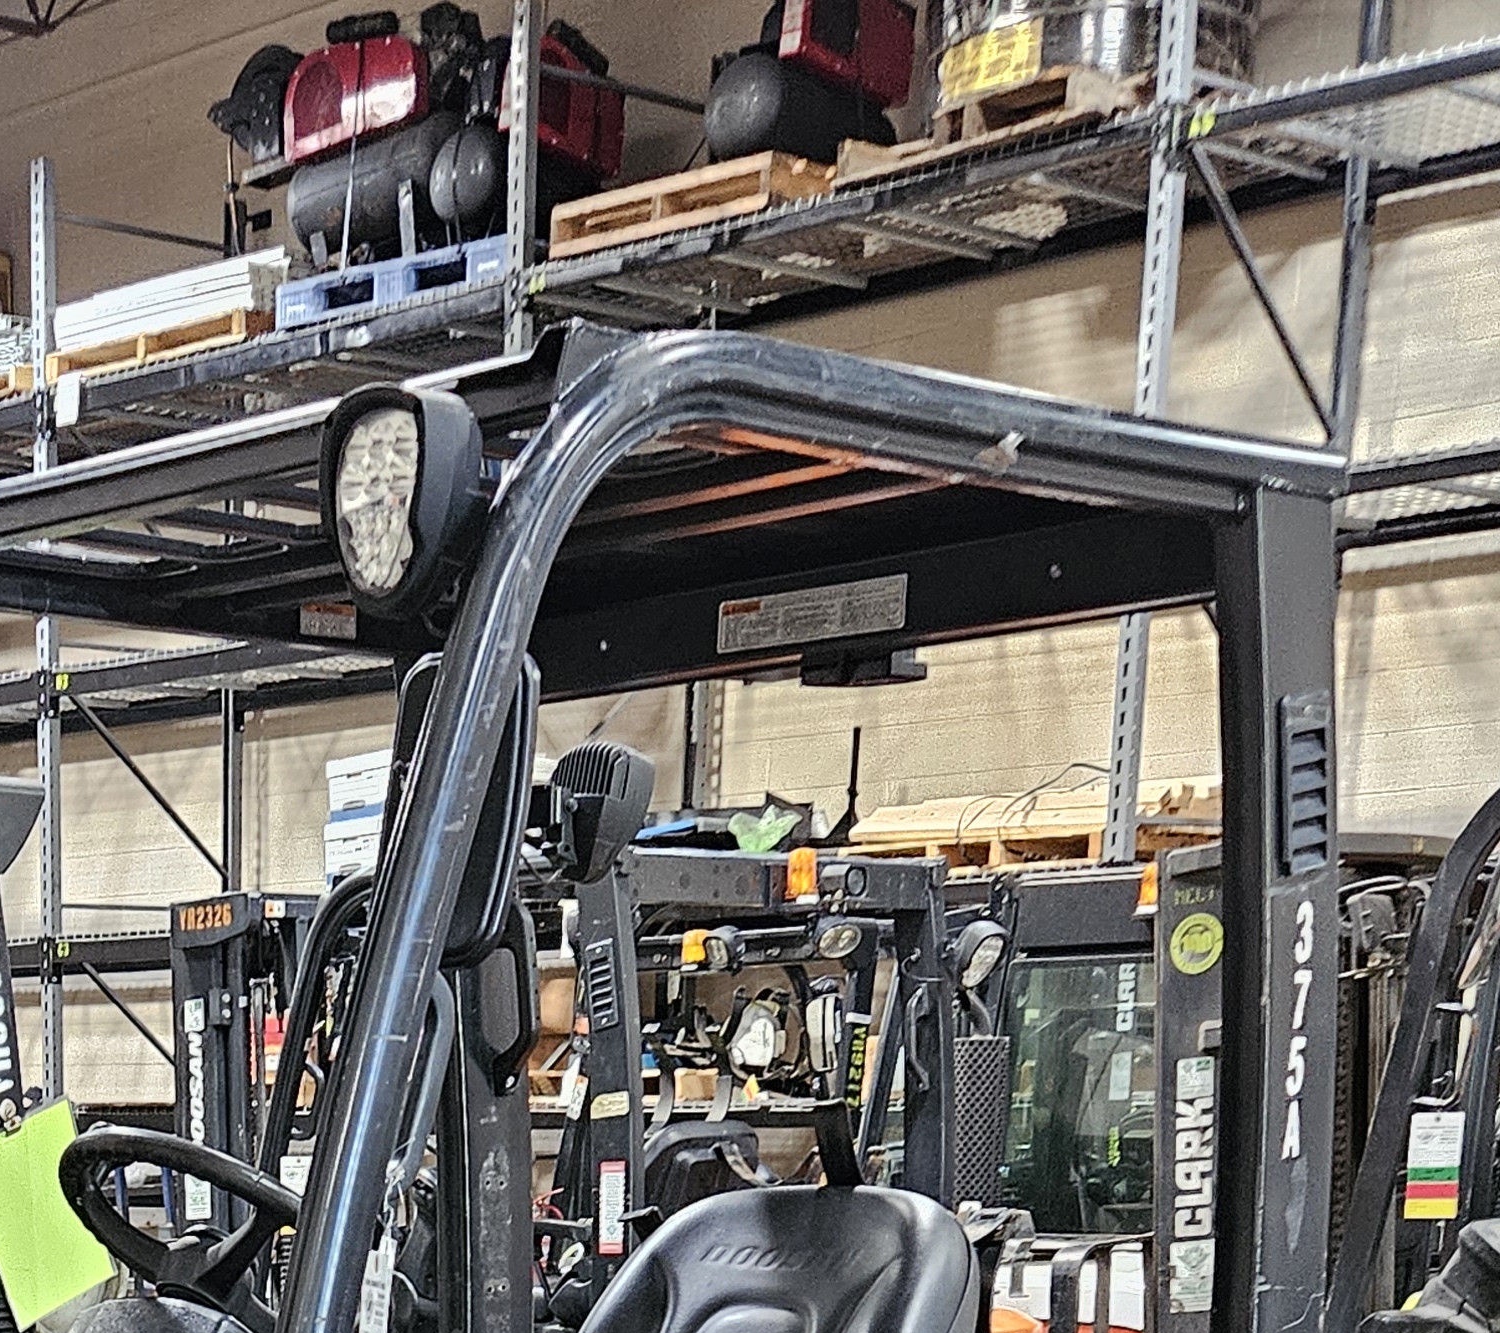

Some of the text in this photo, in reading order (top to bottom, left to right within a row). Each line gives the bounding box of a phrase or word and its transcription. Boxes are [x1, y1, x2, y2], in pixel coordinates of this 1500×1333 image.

[179, 902, 233, 931] VR2326
[1116, 962, 1136, 1032] CLAR
[1281, 900, 1314, 1161] 375A
[188, 1031, 205, 1146] OOSAN
[1174, 1096, 1214, 1239] CLARK
